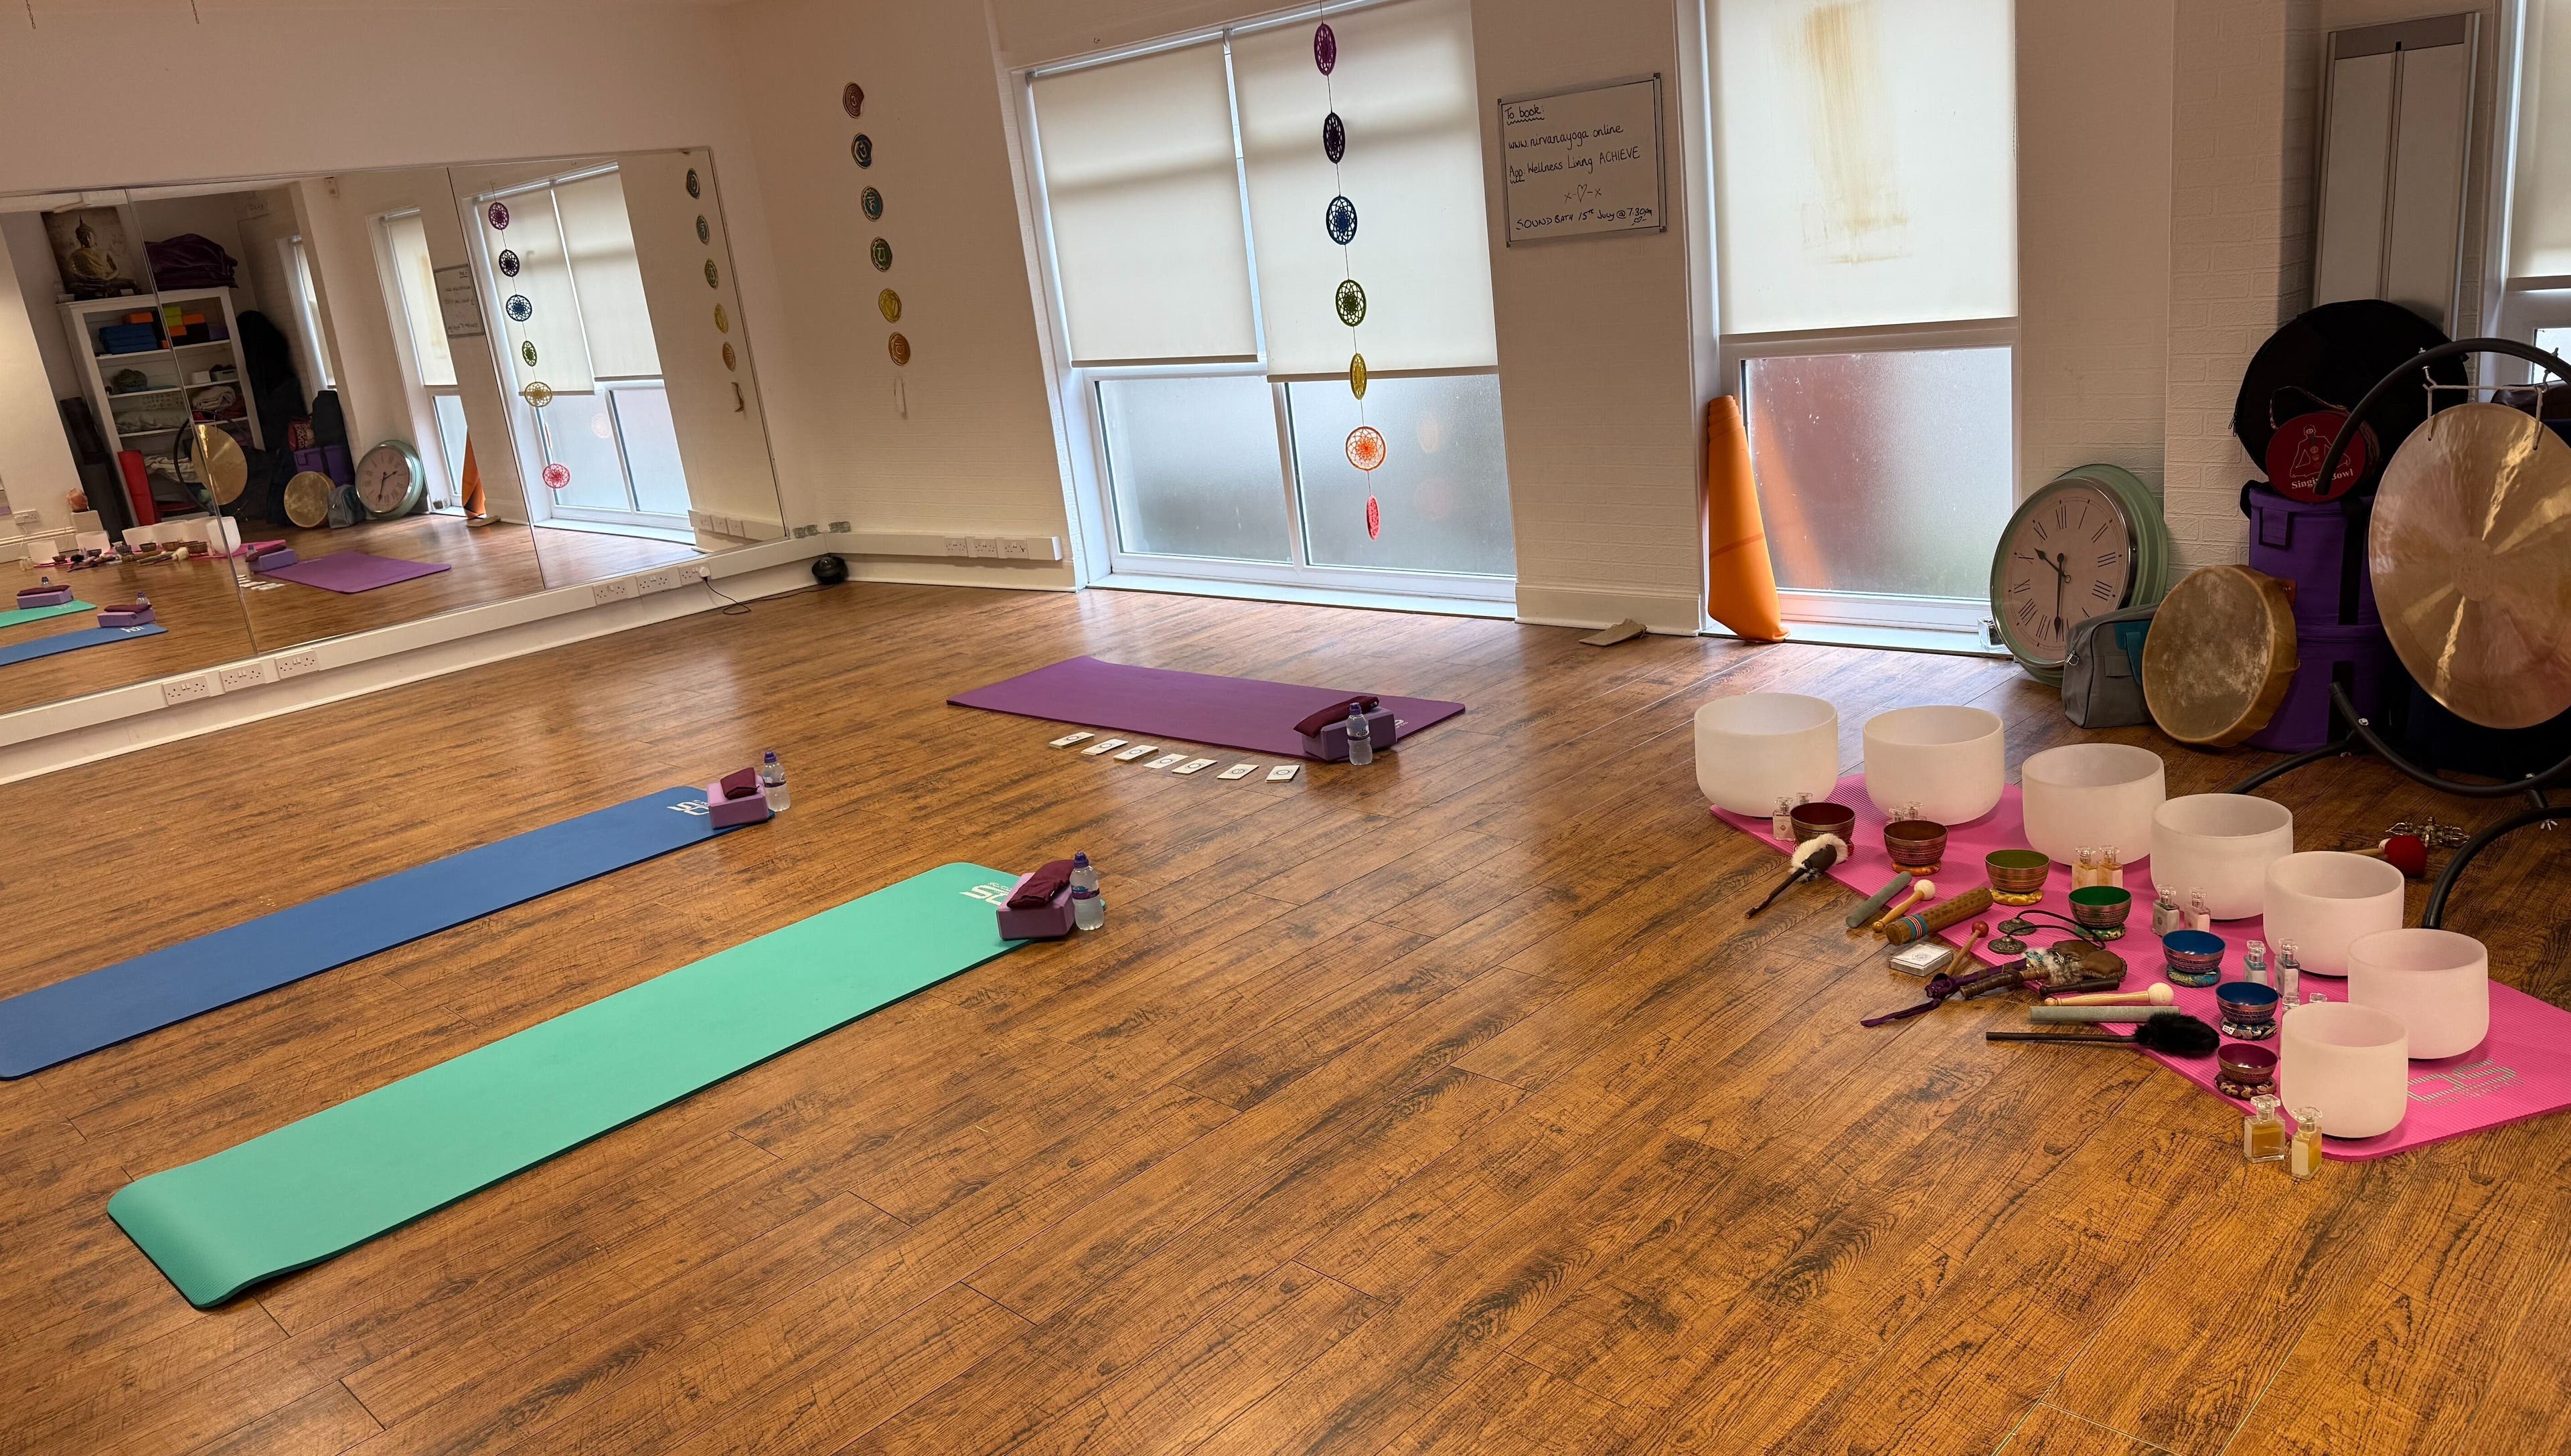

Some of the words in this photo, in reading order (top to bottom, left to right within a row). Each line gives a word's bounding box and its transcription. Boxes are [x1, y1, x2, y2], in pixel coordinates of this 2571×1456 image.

[1504, 106, 1514, 120] To
[1527, 161, 1563, 174] Wellness
[1567, 155, 1593, 174] Living
[1600, 146, 1640, 165] ACHIEVE
[1516, 216, 1553, 230] SOUND
[2291, 476, 2319, 489] Singi
